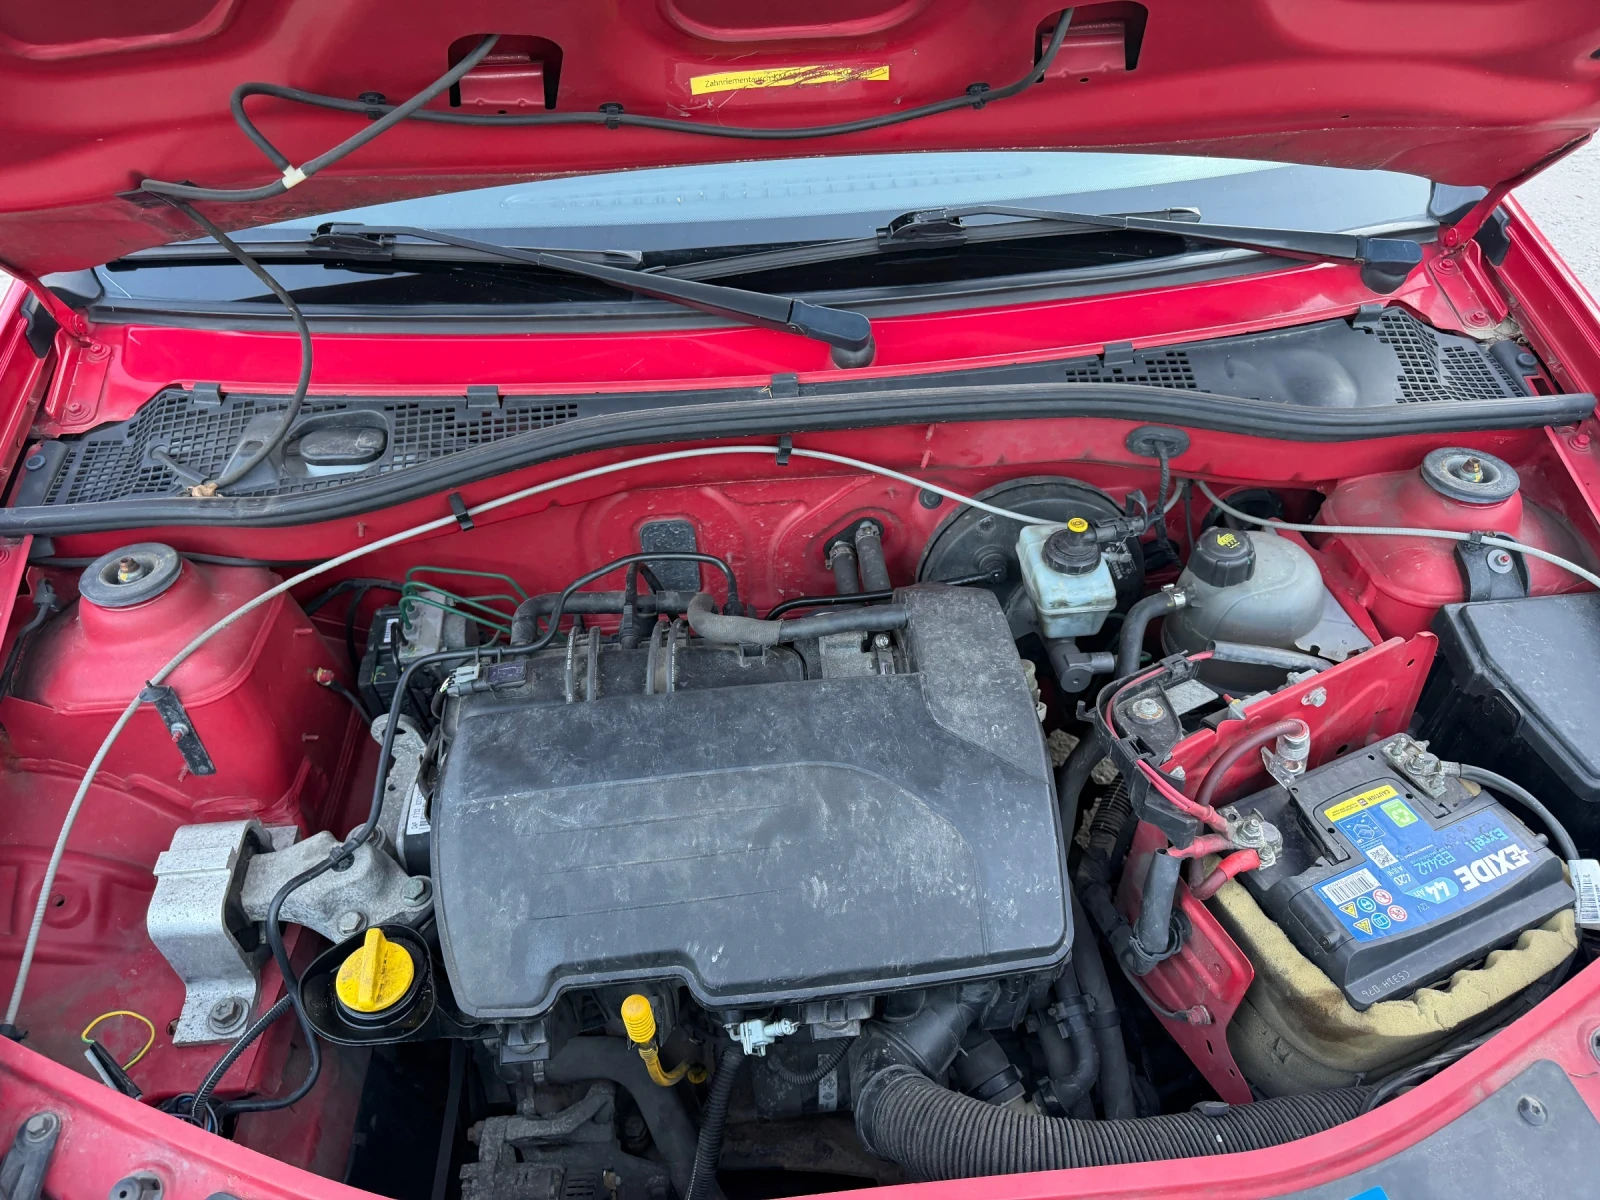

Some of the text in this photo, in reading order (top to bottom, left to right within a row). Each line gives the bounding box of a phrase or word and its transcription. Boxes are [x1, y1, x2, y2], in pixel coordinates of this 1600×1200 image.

[1367, 789, 1391, 802] CAUTION
[1464, 828, 1509, 852] Excell
[1413, 850, 1457, 876] EB442
[1453, 844, 1531, 892] EXIDE
[1393, 873, 1411, 886] 420
[1424, 881, 1451, 901] 44
[1418, 902, 1430, 912] 12V
